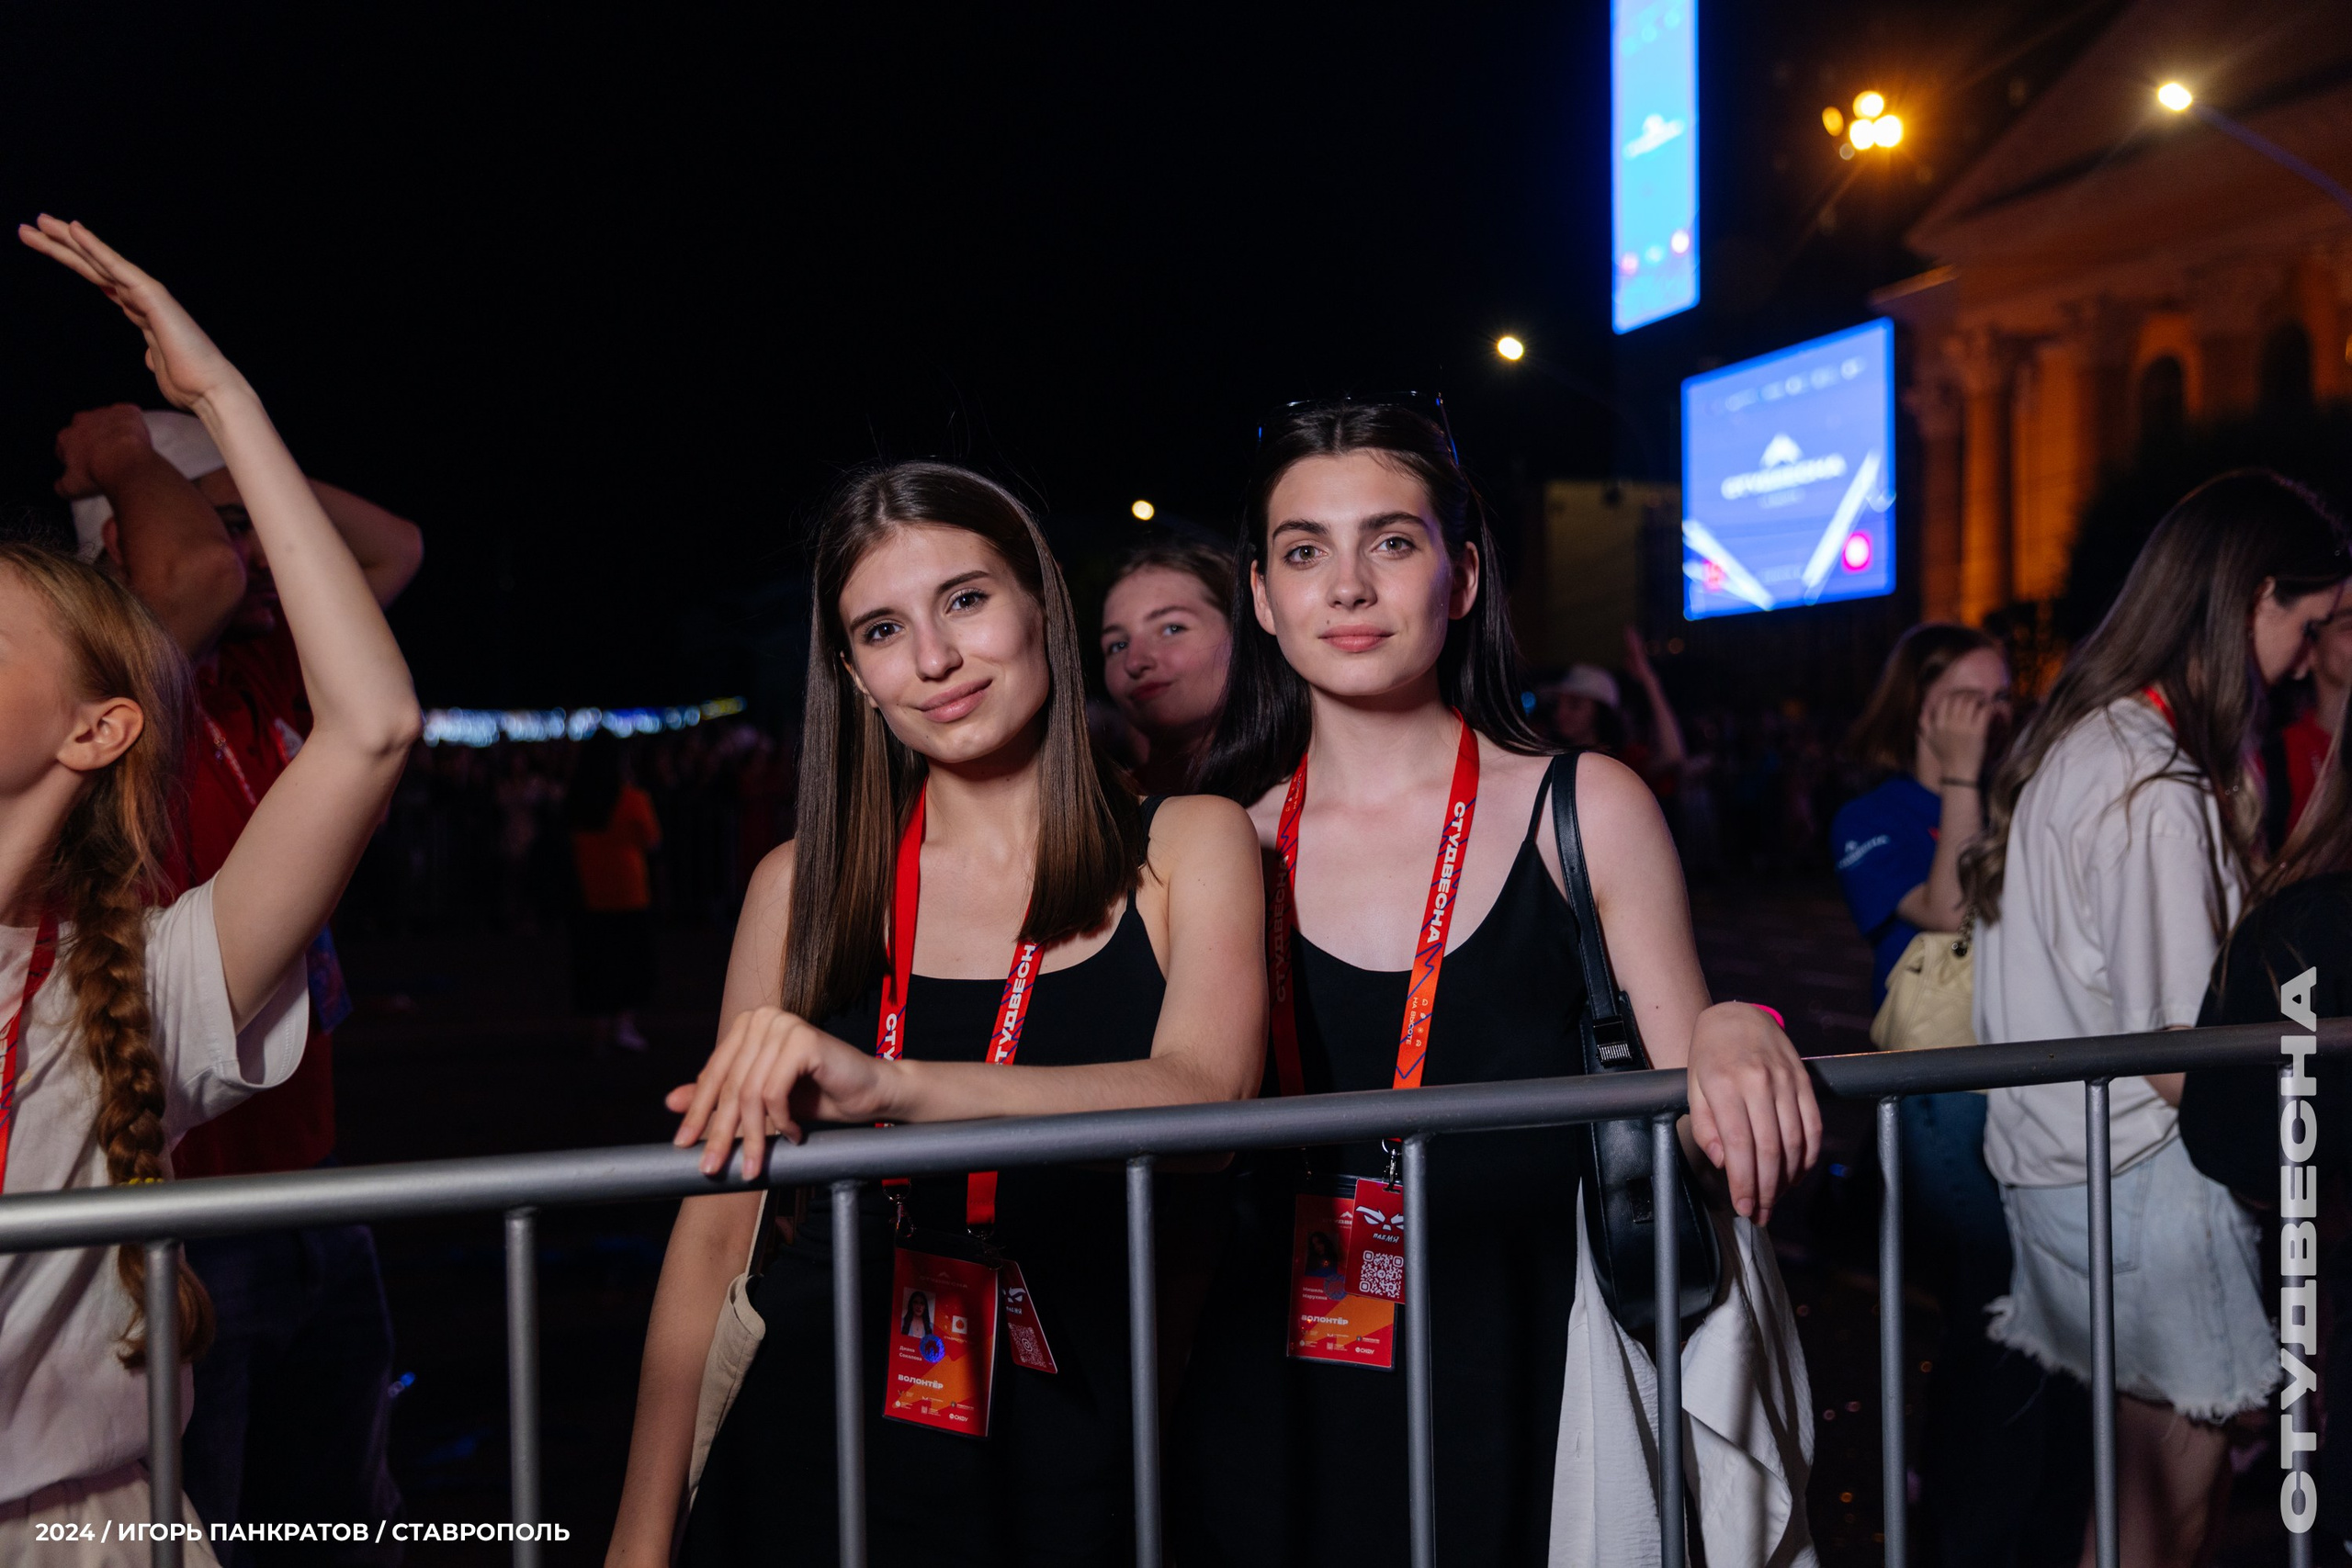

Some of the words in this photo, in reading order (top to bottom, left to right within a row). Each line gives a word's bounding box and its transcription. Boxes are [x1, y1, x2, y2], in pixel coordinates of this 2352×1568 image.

[1273, 854, 1290, 1003] СТУДВЕСНА
[1426, 801, 1466, 943] СТУДВЕСНА
[994, 942, 1037, 1065] ТУДВЕСН
[1406, 1010, 1417, 1045] ВЫСОТЕ
[1411, 997, 1419, 1009] НА
